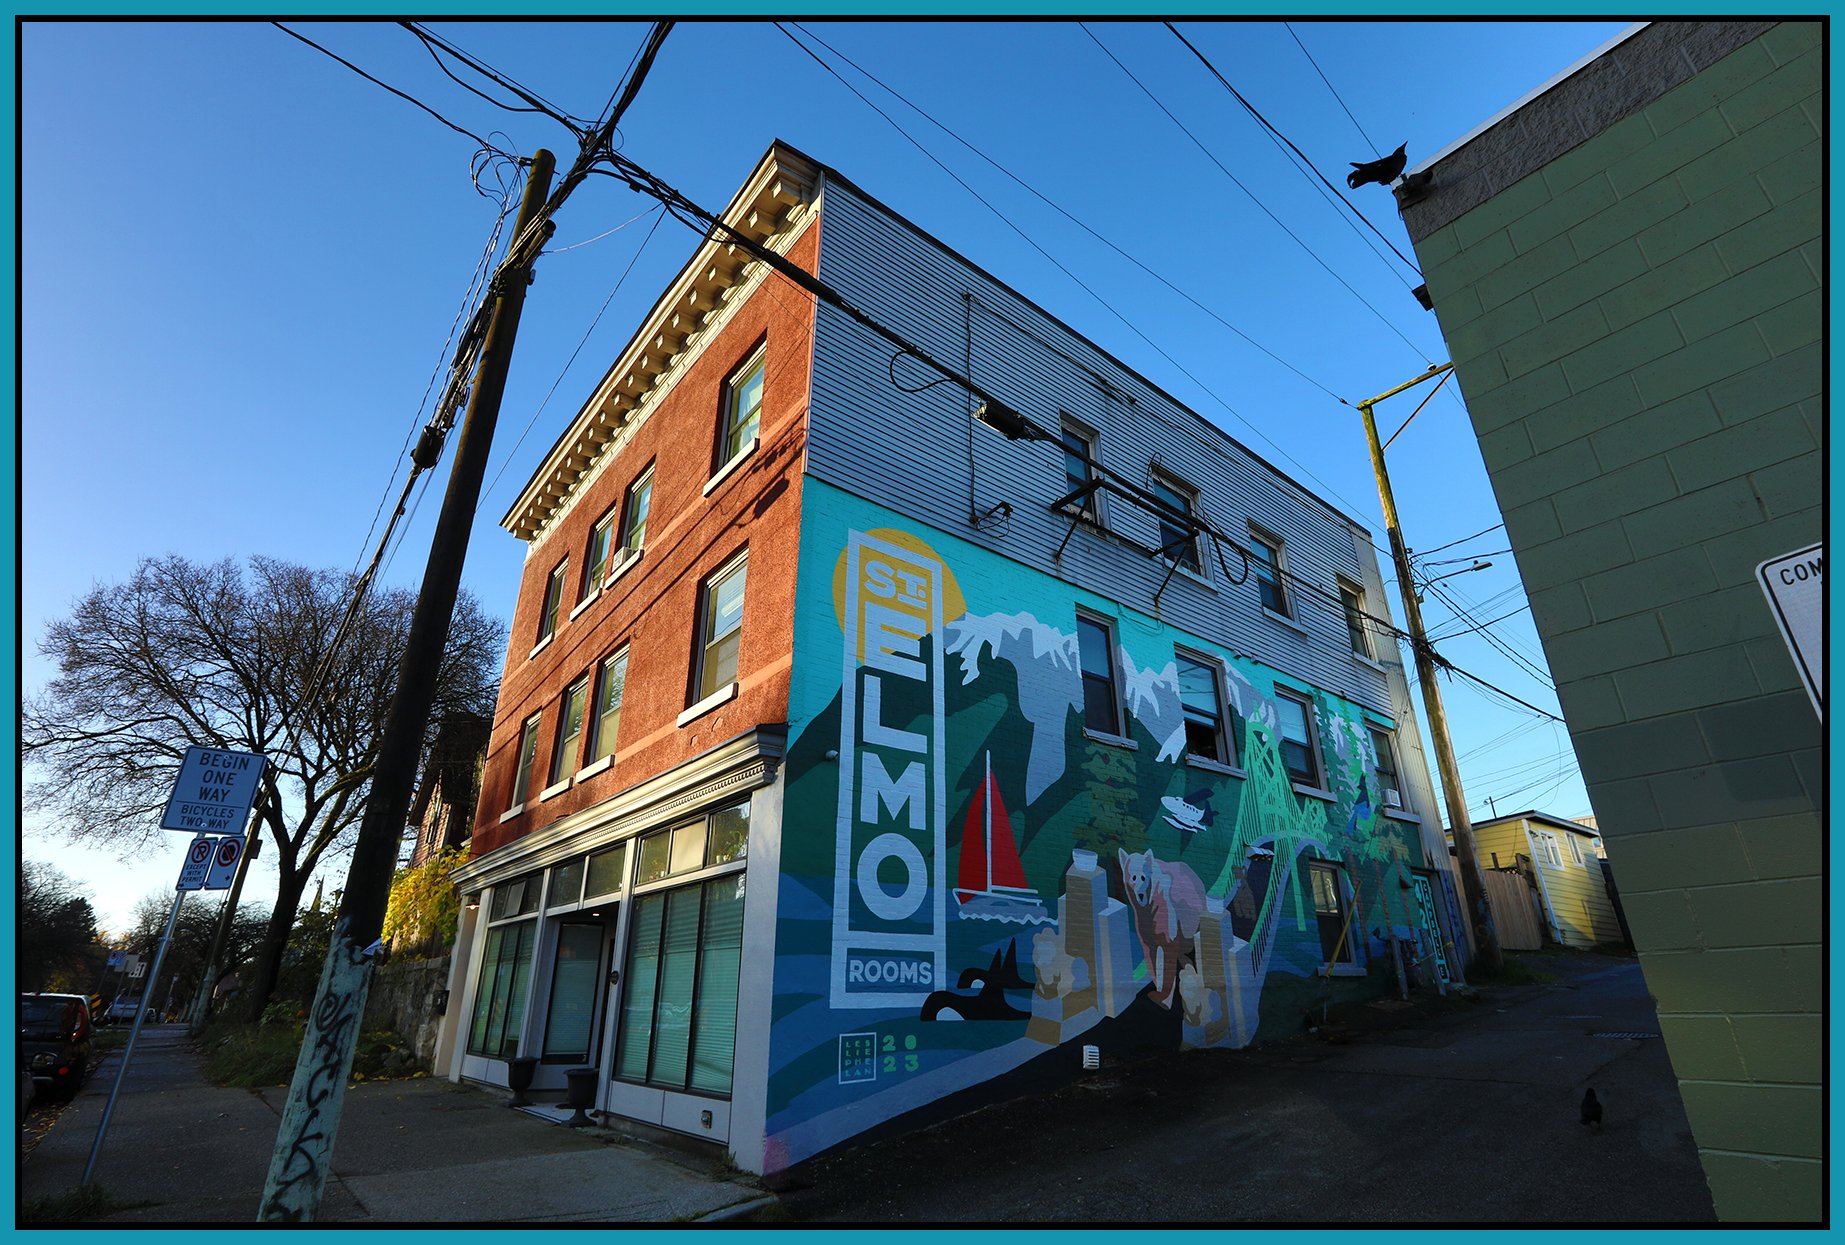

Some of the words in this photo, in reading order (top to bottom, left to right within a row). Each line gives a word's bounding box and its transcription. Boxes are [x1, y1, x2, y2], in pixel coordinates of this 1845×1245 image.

[200, 752, 249, 771] BEGIN
[857, 601, 928, 920] ELMO
[203, 769, 237, 786] ONE
[199, 787, 230, 802] WAY
[181, 804, 235, 819] BICYCLES
[181, 815, 203, 827] TWO
[208, 818, 229, 830] WAY
[186, 863, 207, 871] EXCEPT
[849, 959, 933, 985] ROOMS
